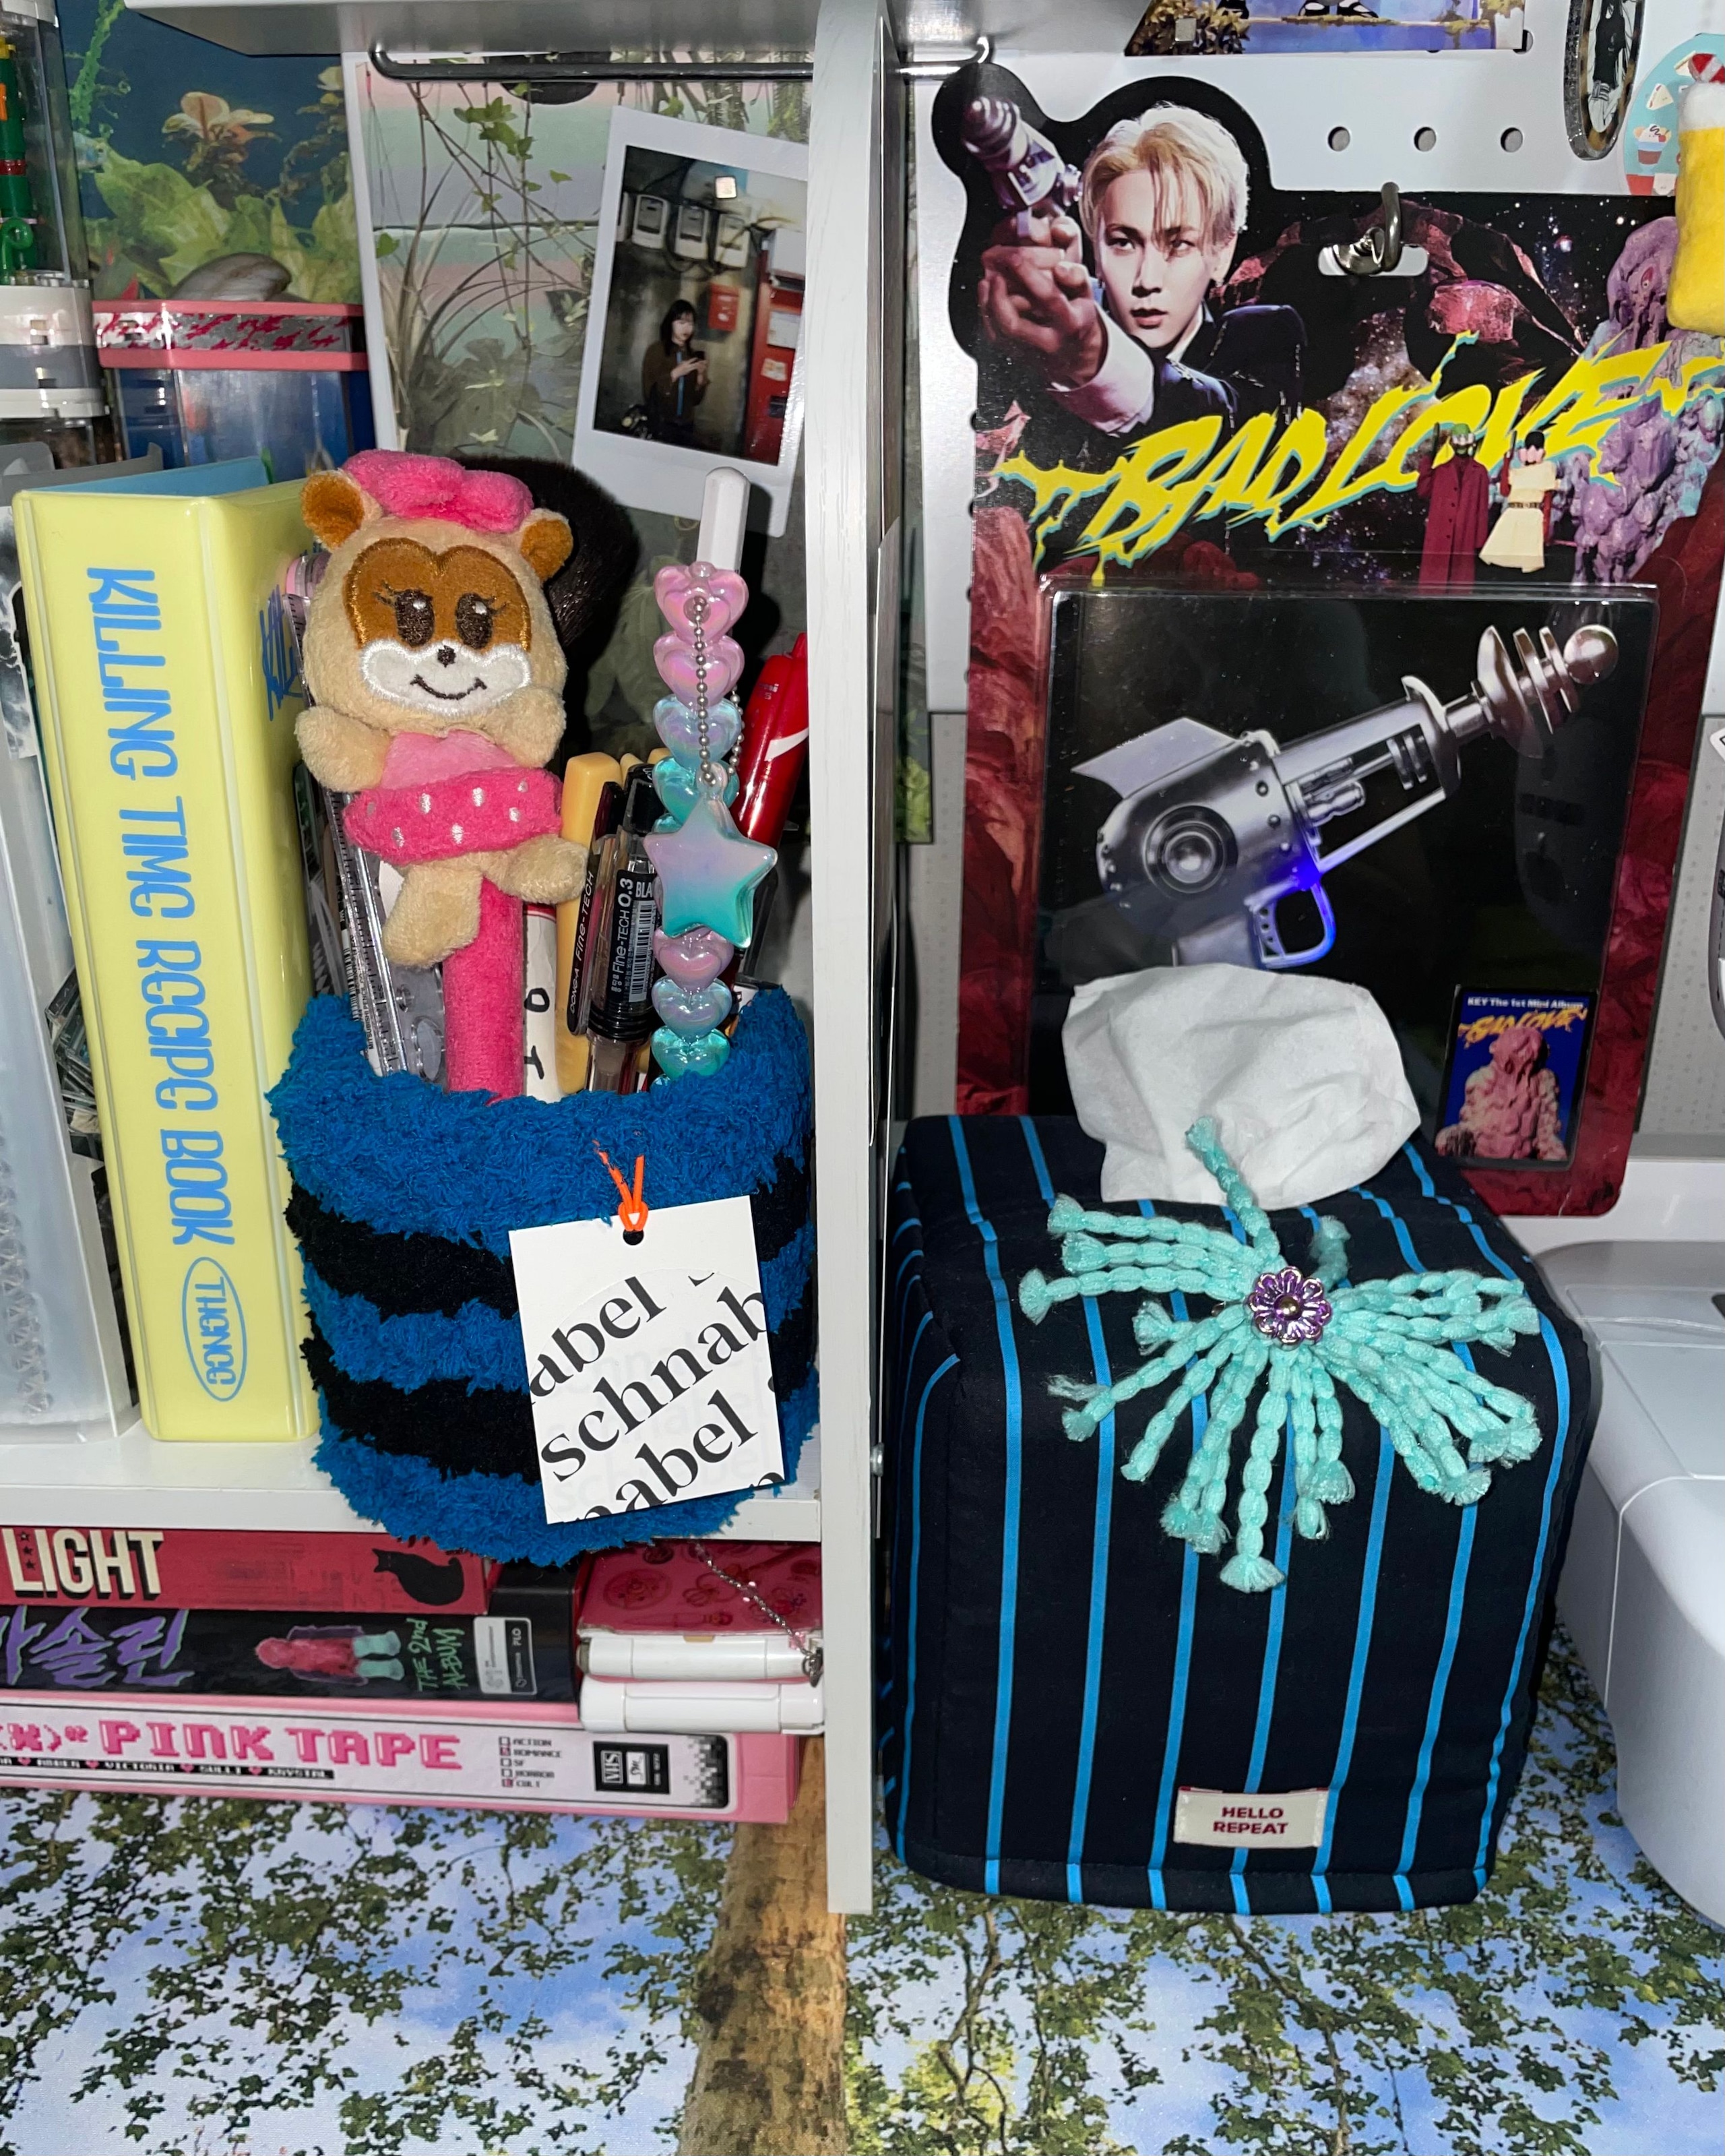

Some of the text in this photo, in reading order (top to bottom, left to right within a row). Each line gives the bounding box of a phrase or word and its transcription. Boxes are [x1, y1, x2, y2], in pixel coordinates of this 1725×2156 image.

[1065, 340, 1672, 566] BAD LOVE
[87, 567, 179, 780] KILLING
[161, 1130, 235, 1246] BOOK
[575, 872, 595, 960] Fine-TECH
[618, 877, 633, 908] 0.3
[1468, 997, 1583, 1011] KEY The 1st Mini Album
[1, 1528, 164, 1599] LIGHT
[406, 1618, 439, 1692] THE 2nd
[431, 1628, 468, 1691] ALBUM
[98, 1719, 274, 1761] PINK
[284, 1727, 463, 1770] TAPE
[604, 1752, 620, 1782] VHS
[1212, 1821, 1289, 1835] REPEAT
[1221, 1806, 1284, 1819] HELLO
